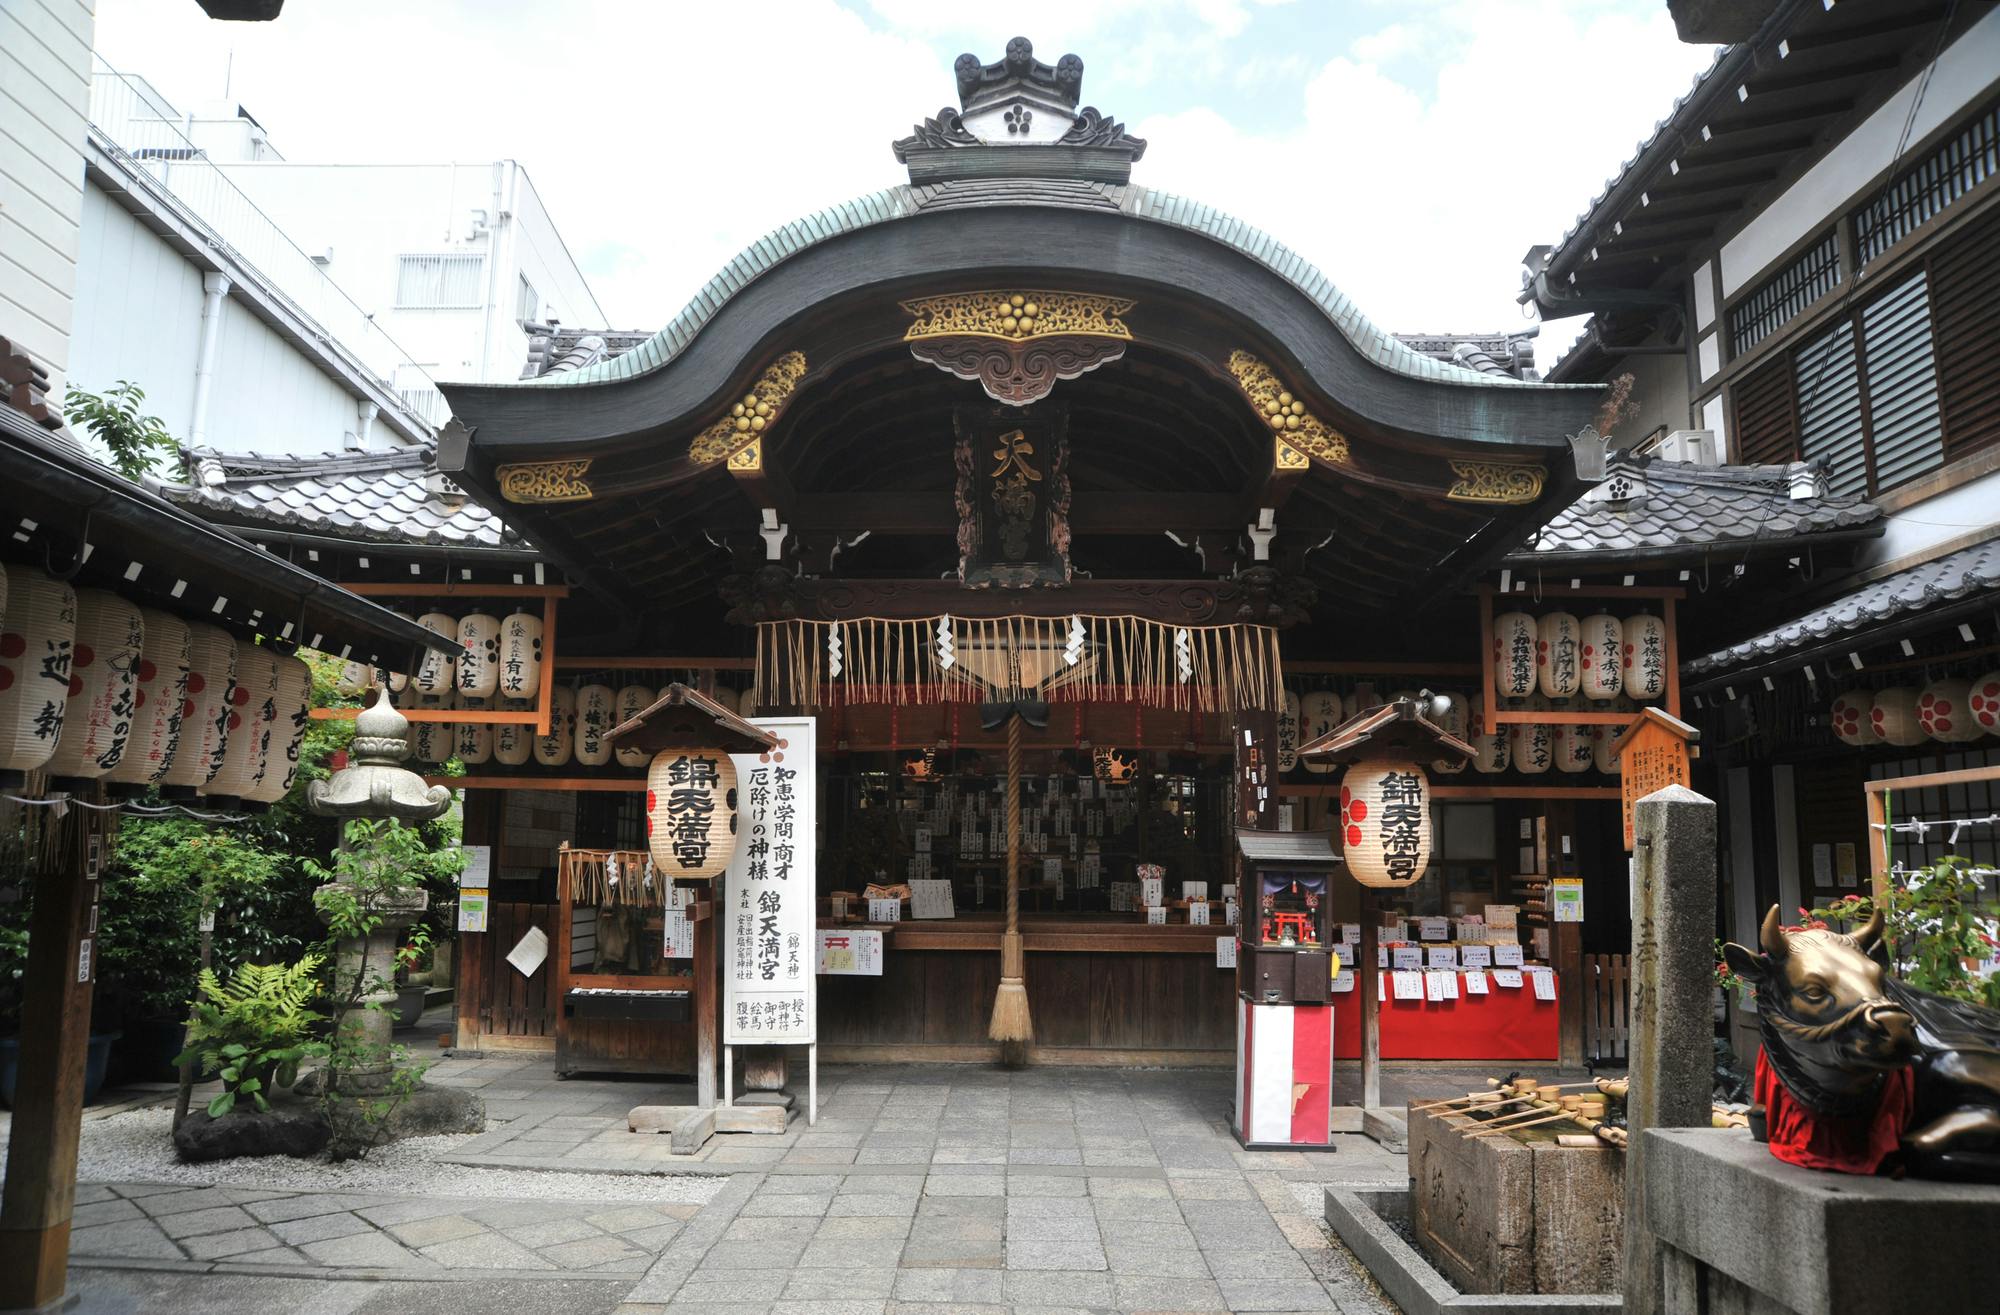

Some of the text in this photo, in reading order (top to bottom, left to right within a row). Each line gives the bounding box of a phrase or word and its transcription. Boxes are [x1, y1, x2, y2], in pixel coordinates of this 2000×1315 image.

[460, 650, 477, 688] 大友
[505, 657, 524, 692] 有次
[1600, 637, 1620, 692] 京秀味
[460, 725, 479, 756] 竹林
[498, 727, 514, 753] 正和
[667, 755, 720, 869] 錦天満宮
[747, 767, 771, 880] 厄除けの神様
[1378, 772, 1423, 881] 錦天満宮
[740, 888, 750, 909] 末社
[757, 890, 781, 980] 錦天満宮
[736, 1001, 748, 1031] 腹帯
[750, 1001, 764, 1031] 絵馬
[764, 1001, 777, 1031] 御守
[778, 1001, 791, 1031] 御神符
[792, 998, 804, 1027] 授与
